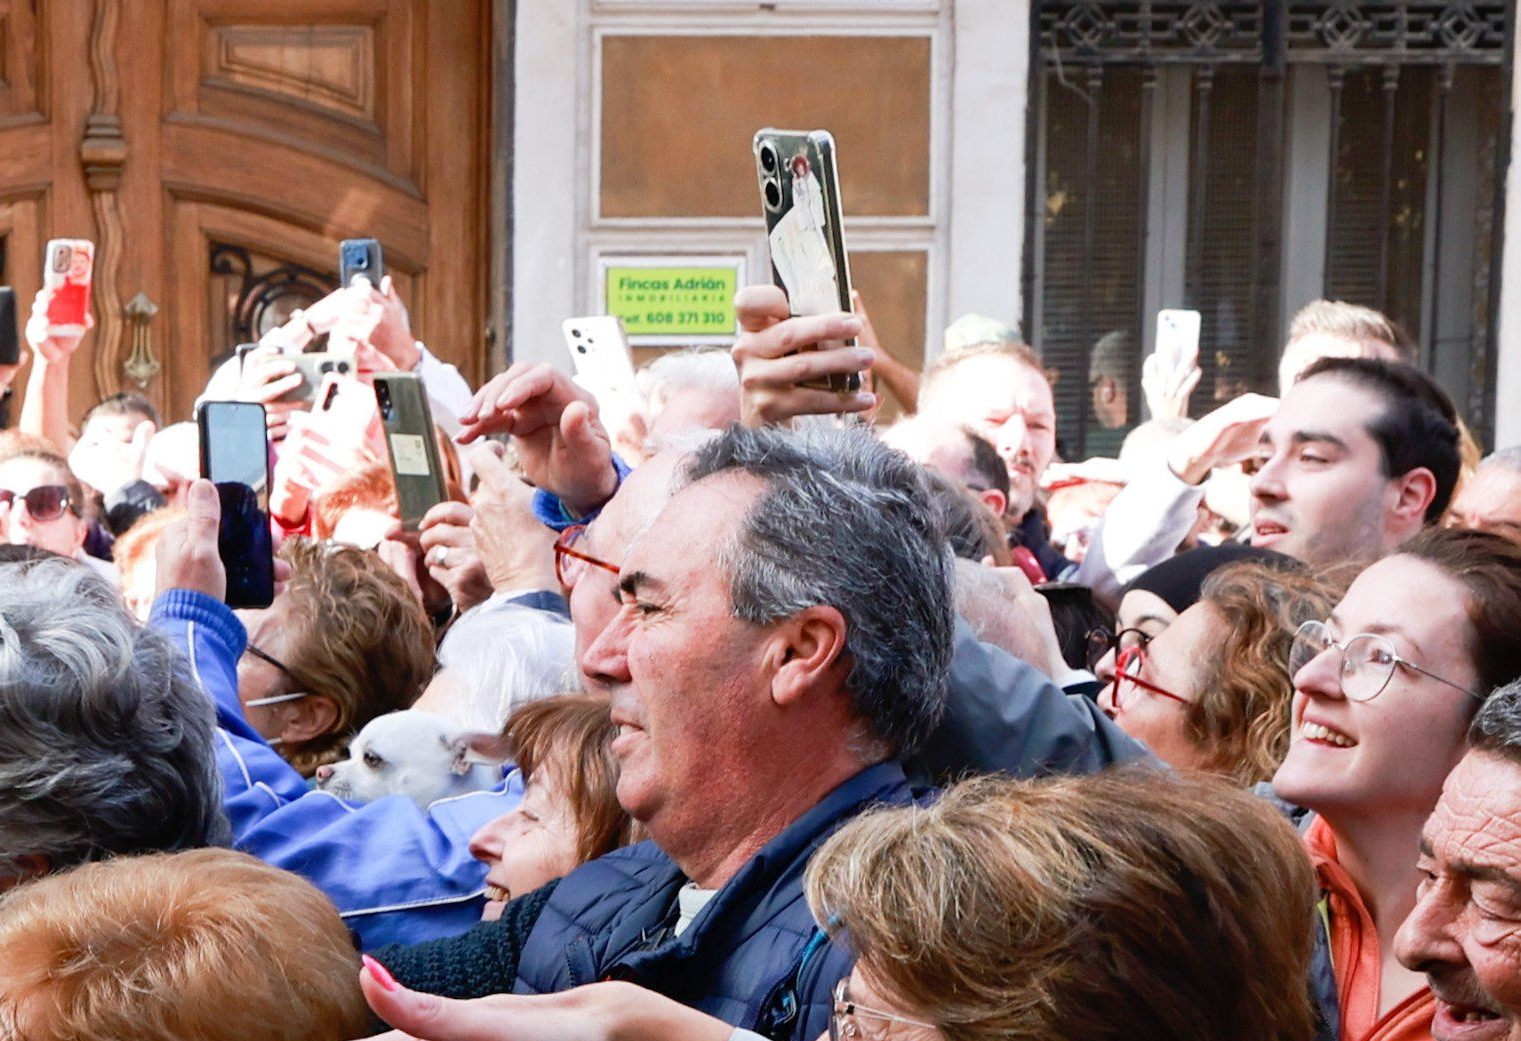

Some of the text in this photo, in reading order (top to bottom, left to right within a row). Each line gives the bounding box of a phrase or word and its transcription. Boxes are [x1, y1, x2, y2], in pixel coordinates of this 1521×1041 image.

[620, 277, 725, 290] Fincas Adrián
[647, 312, 673, 323] 608
[679, 312, 698, 323] 371
[703, 312, 725, 323] 310
